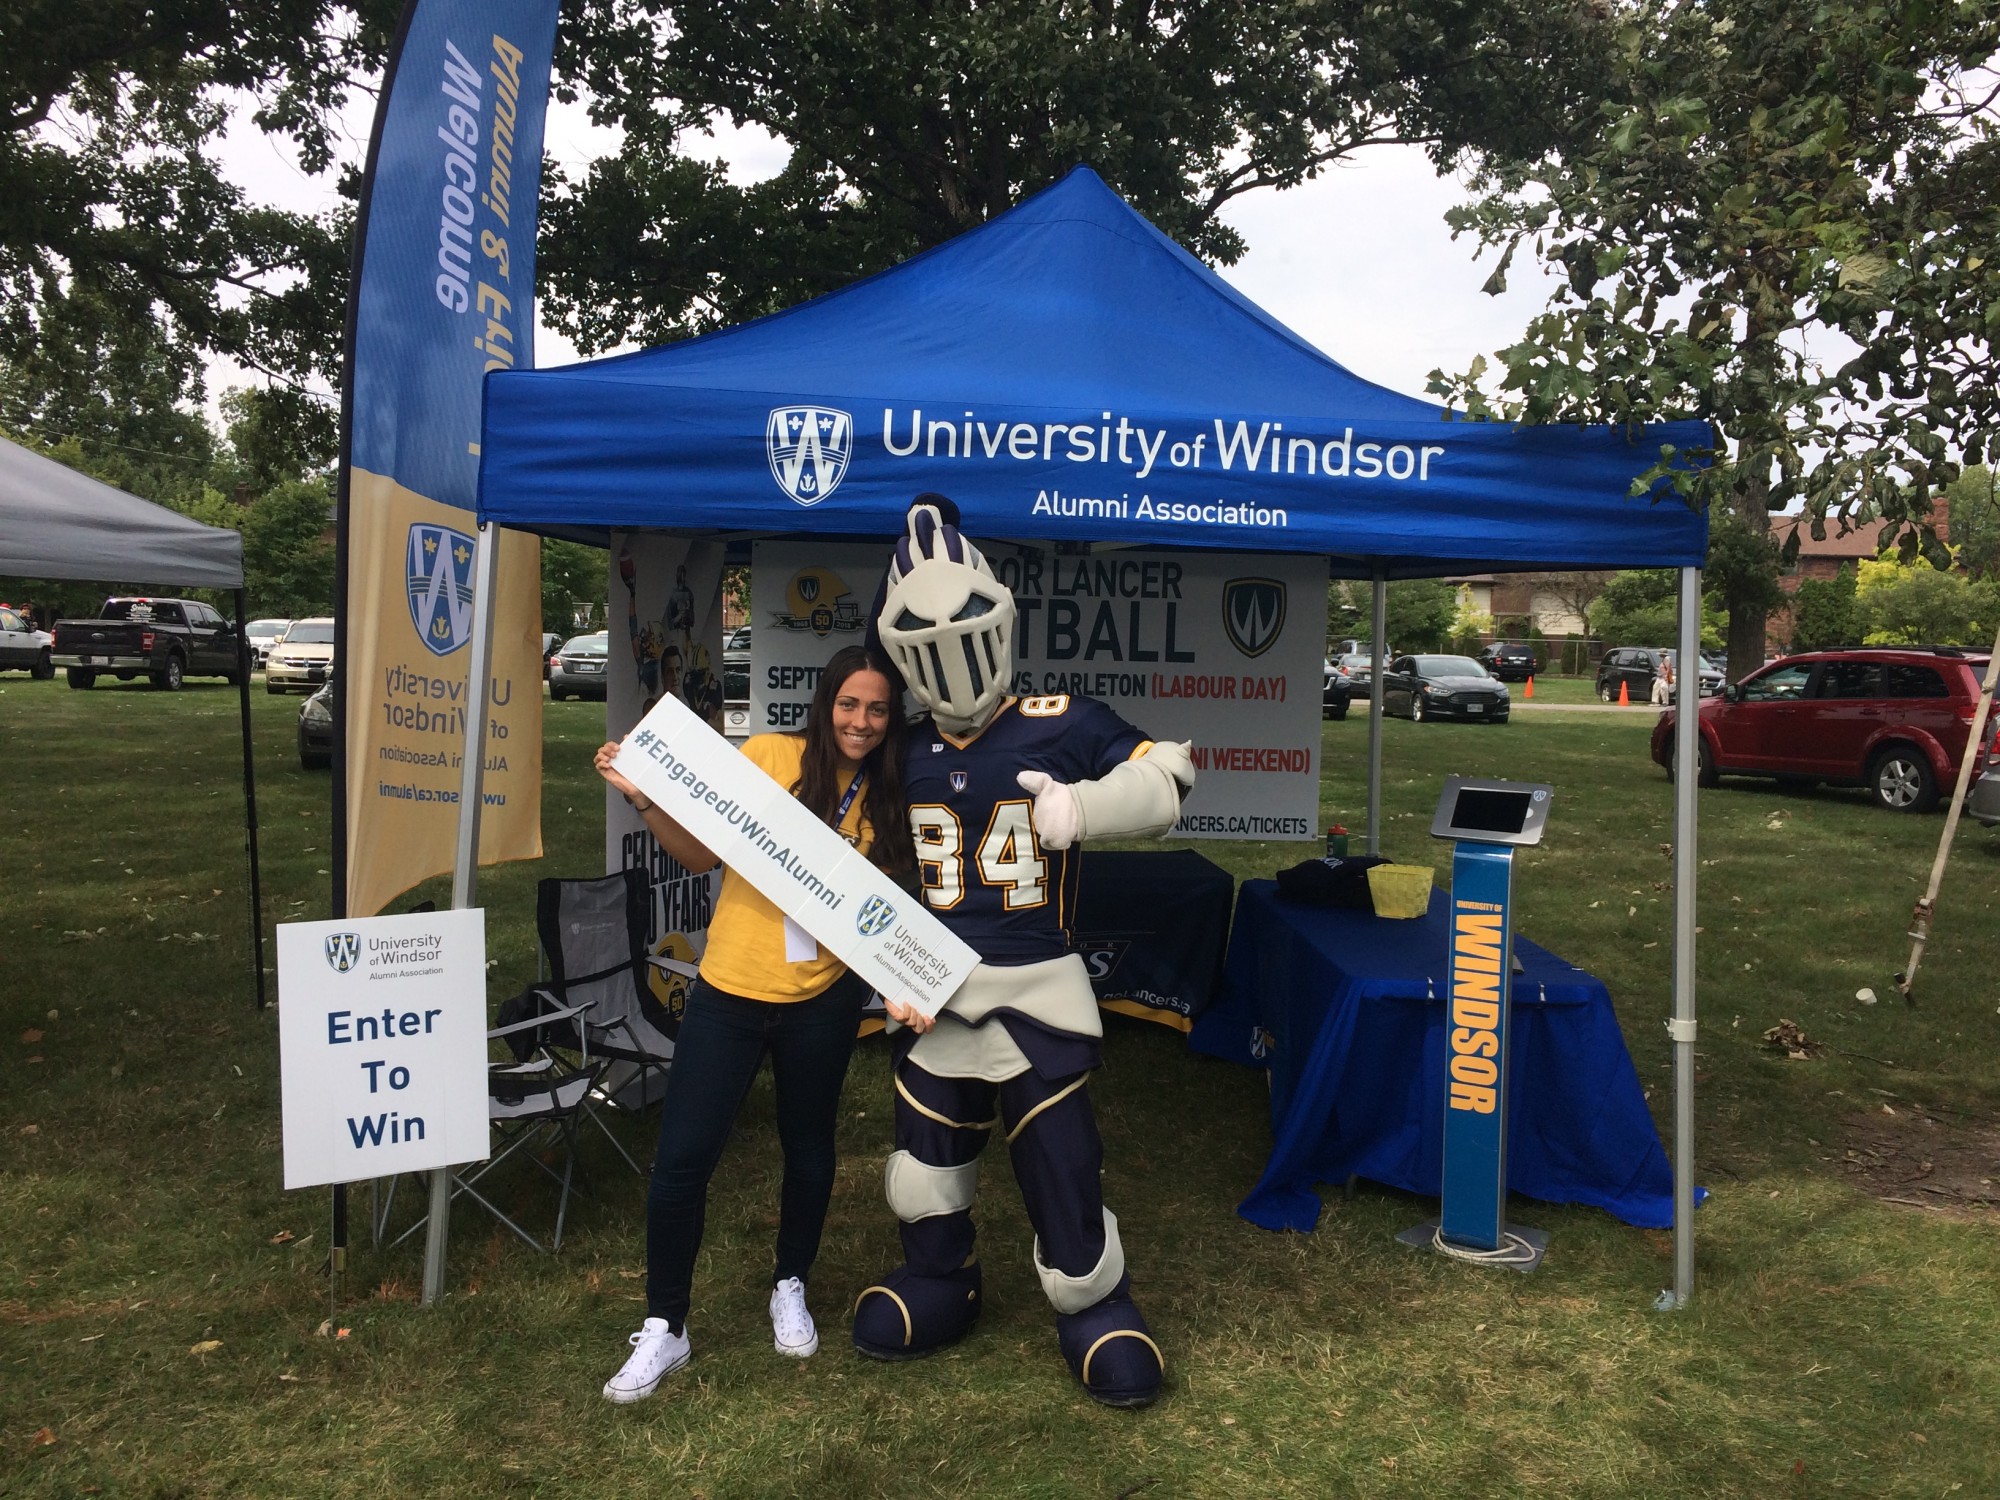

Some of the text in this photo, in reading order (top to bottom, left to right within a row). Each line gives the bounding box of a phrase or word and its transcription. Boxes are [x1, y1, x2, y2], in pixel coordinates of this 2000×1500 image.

[882, 408, 1445, 481] University of Windsor
[1032, 489, 1288, 528] Alumni Association
[1053, 558, 1183, 599] LANCER
[815, 614, 830, 626] 50
[1015, 597, 1196, 664] TBALL
[1043, 671, 1146, 697] CARLETON
[1151, 672, 1237, 701] (LABOUR
[1241, 675, 1287, 703] DAY)
[1212, 746, 1311, 776] WEEKEND)
[633, 728, 846, 912] #EngagedUWinAlumni
[908, 798, 1049, 912] 84
[661, 873, 711, 934] YEARS
[1494, 903, 1503, 913] OF
[369, 934, 443, 951] University
[369, 949, 443, 966] of Windsor
[894, 924, 952, 980] University
[369, 966, 444, 981] Alumni Association
[872, 952, 931, 1004] Alumni Association
[883, 941, 942, 990] of Windsor
[671, 997, 683, 1012] 50
[1450, 913, 1503, 1116] WINDSOR
[327, 1008, 443, 1045] Enter
[360, 1060, 410, 1094] To
[346, 1111, 426, 1149] Win
